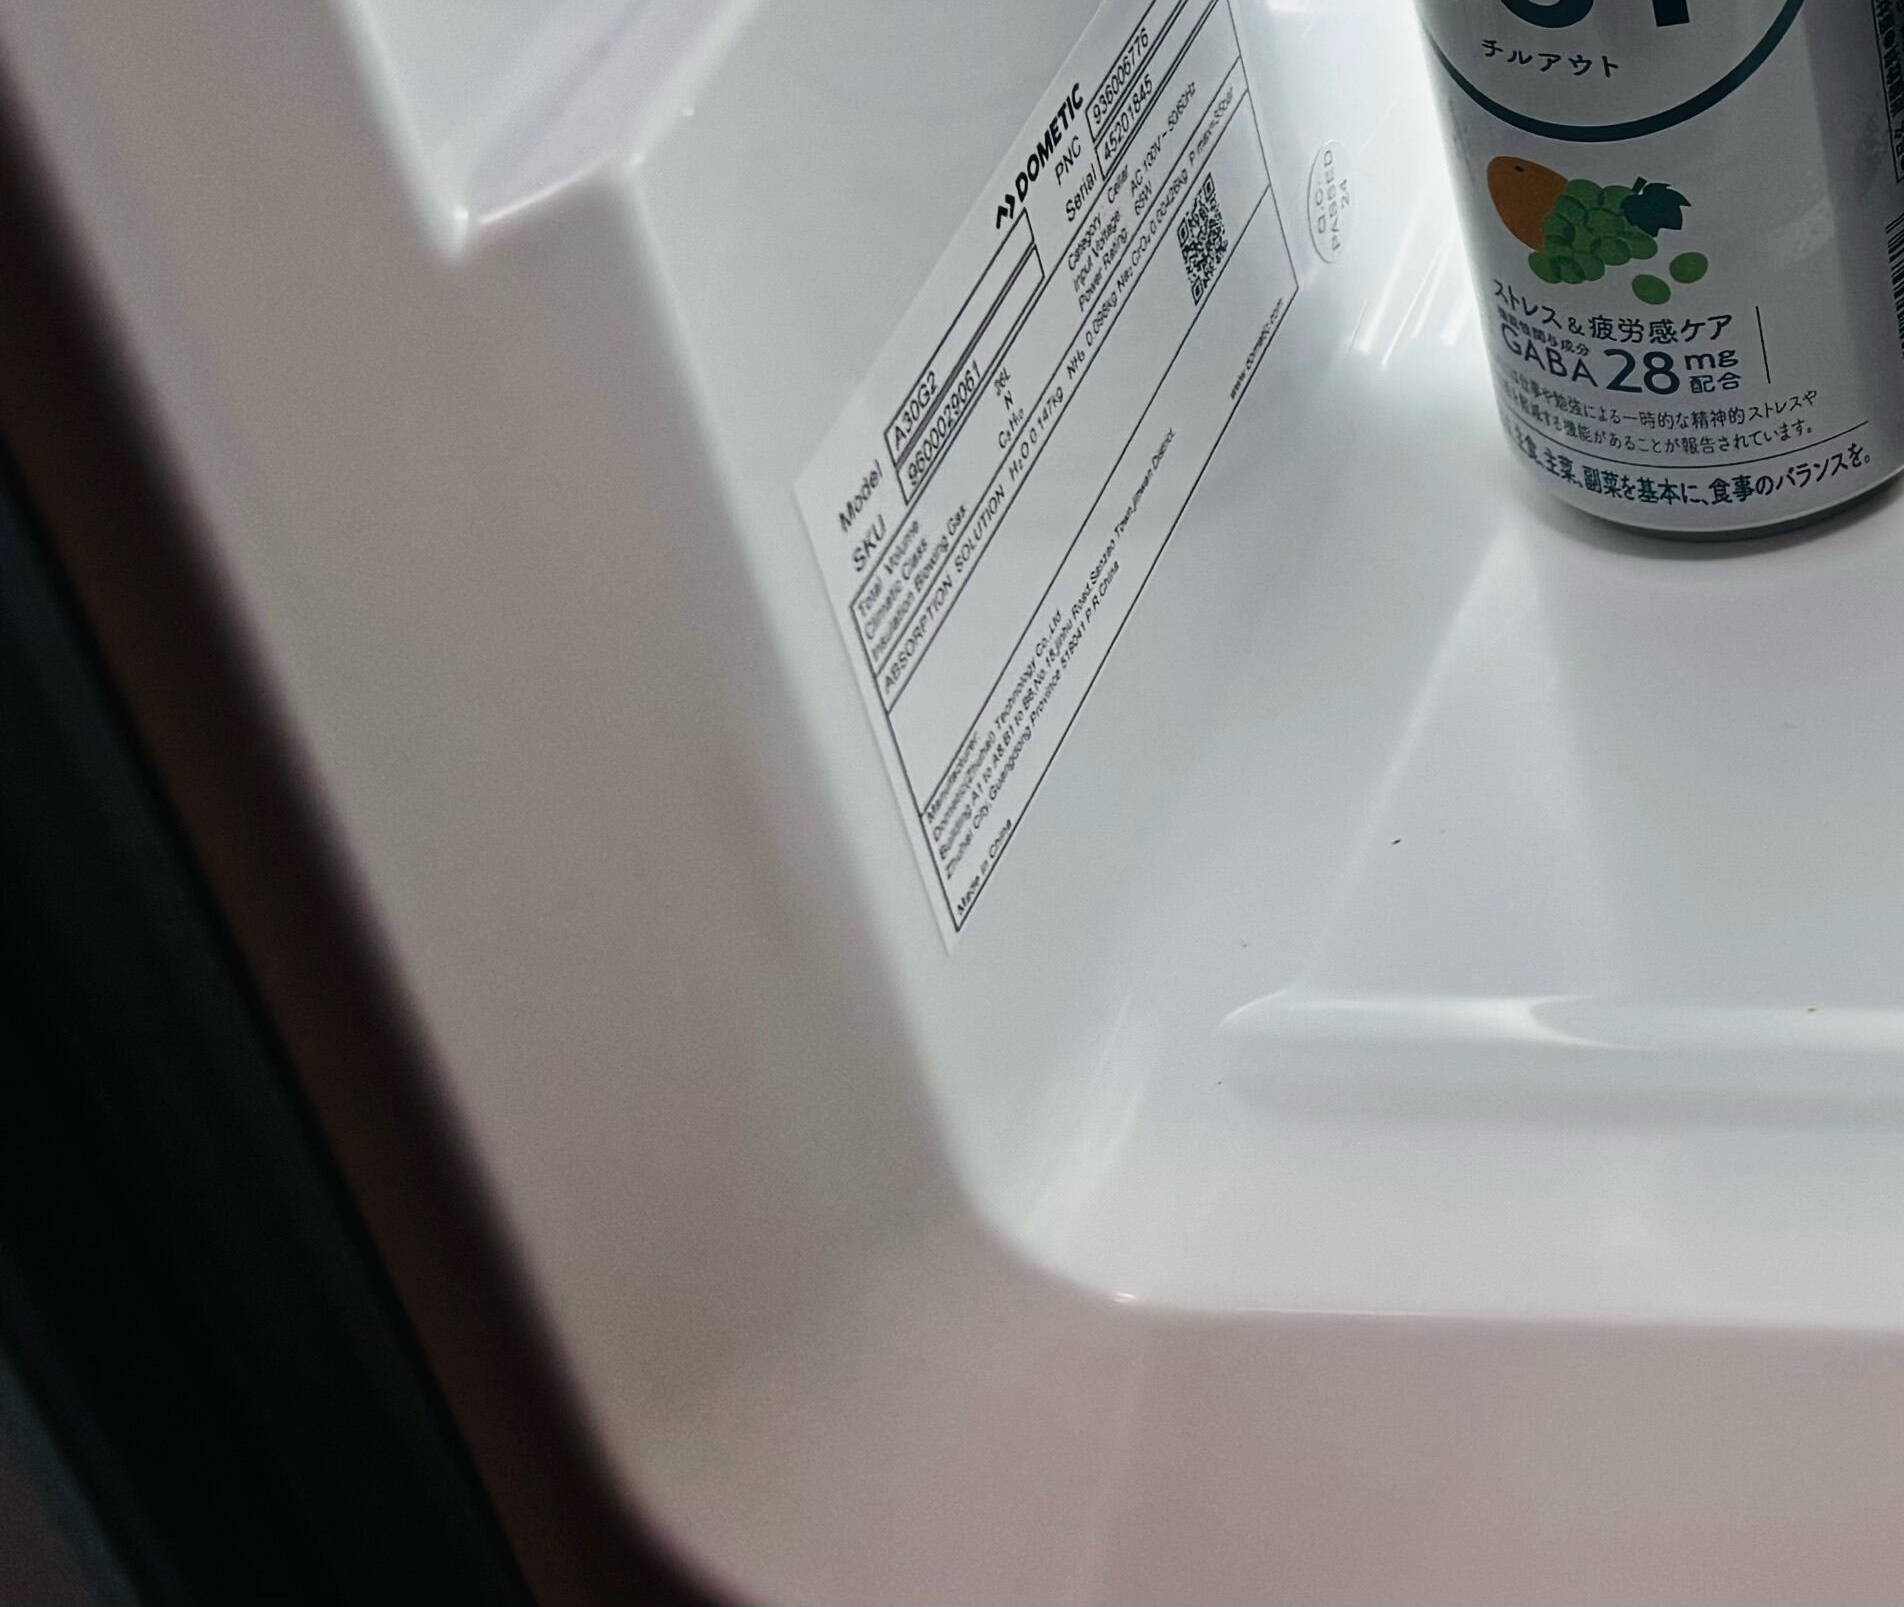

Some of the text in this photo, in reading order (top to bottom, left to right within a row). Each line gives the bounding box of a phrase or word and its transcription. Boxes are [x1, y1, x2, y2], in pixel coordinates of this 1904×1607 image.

[1481, 39, 1620, 81] チルアウト
[1014, 82, 1084, 203] DOMETIC
[1053, 134, 1082, 187] PNC
[1064, 162, 1098, 223] Serial
[1501, 322, 1740, 395] GABA 28 mg
[1689, 371, 1742, 395] 配合
[838, 369, 938, 533] Model A30G2
[851, 513, 887, 573] SKU
[953, 483, 1006, 574] SOLUTION
